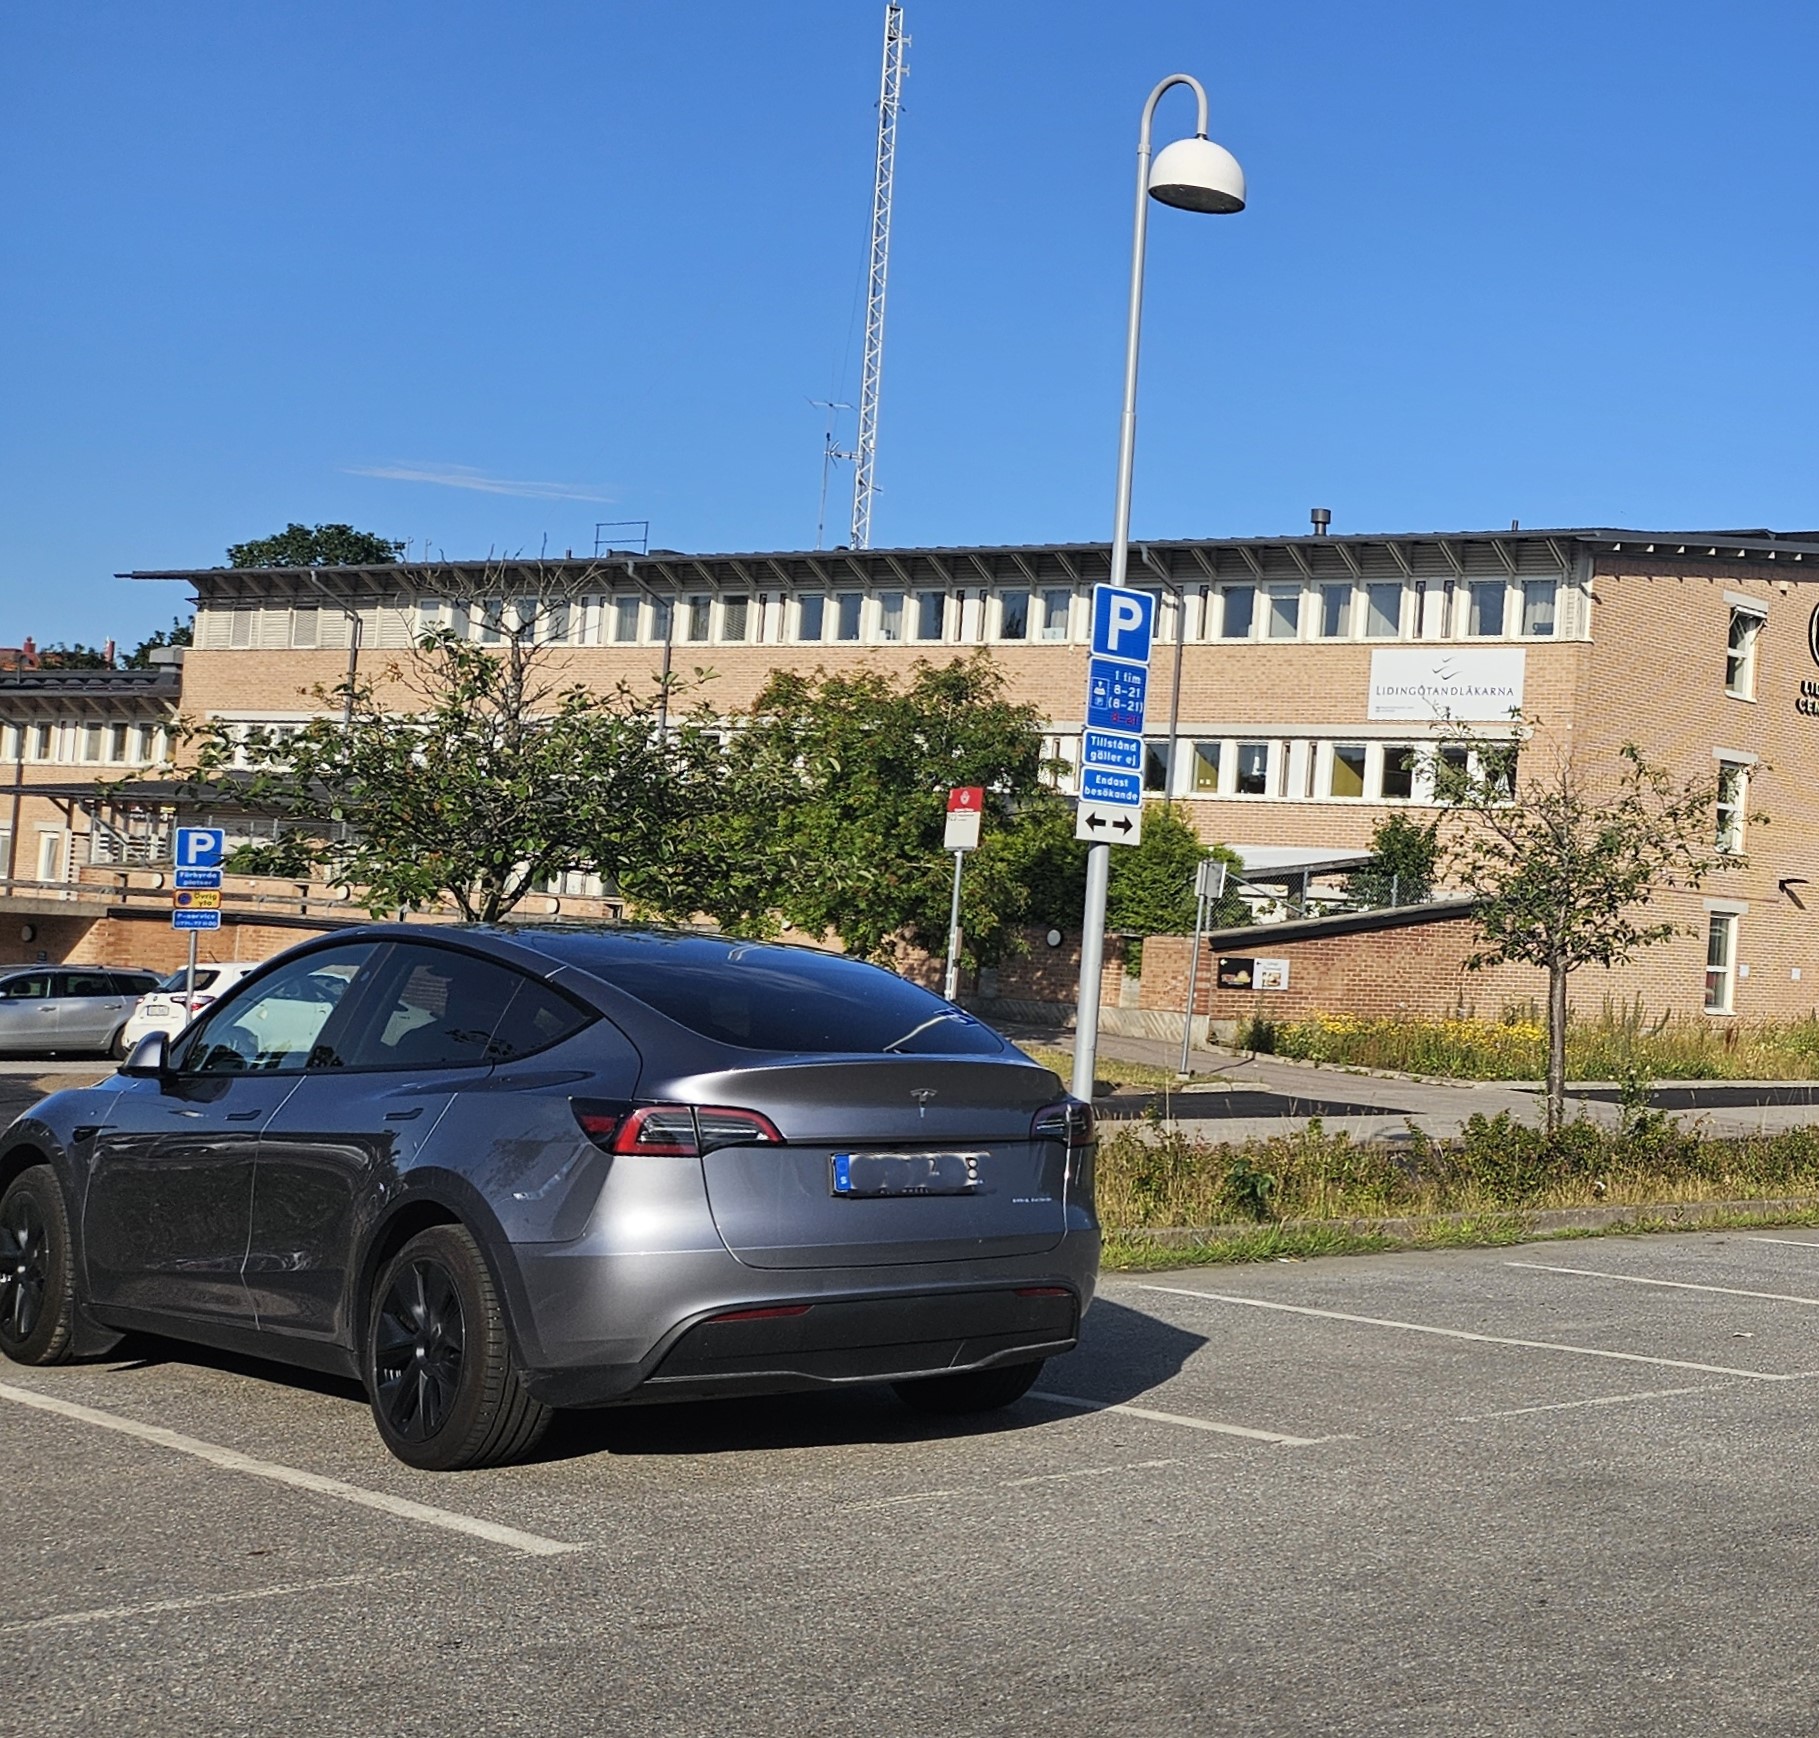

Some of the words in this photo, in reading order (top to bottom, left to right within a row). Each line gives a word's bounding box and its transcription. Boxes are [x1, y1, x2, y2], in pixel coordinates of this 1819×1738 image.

[1107, 594, 1144, 651] P
[1114, 670, 1120, 681] 1
[1123, 672, 1142, 684] tim
[1113, 684, 1141, 698] 8-21
[1108, 696, 1143, 714] (8-21)
[1089, 735, 1138, 753] Tillstånd
[1089, 749, 1123, 765] gäller
[1125, 752, 1137, 767] ej
[1095, 774, 1129, 788] Endast
[1084, 784, 1139, 802] besökande
[188, 832, 216, 864] P
